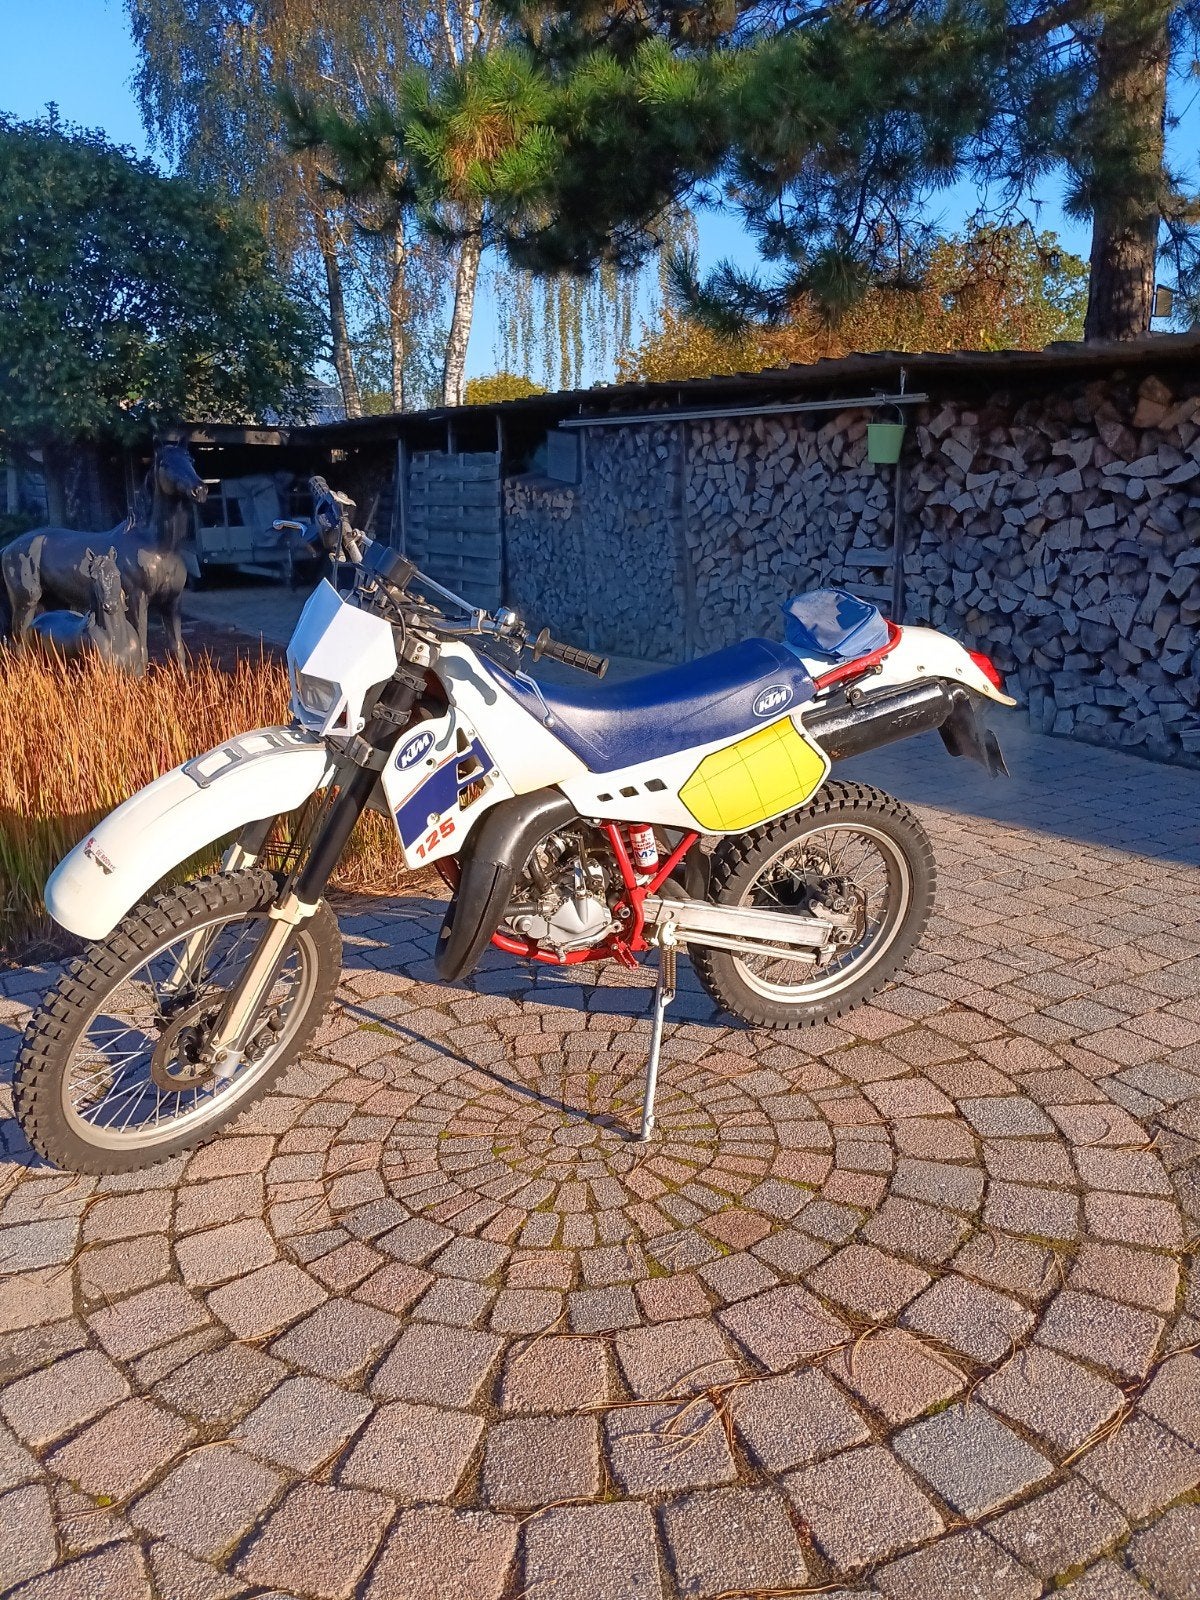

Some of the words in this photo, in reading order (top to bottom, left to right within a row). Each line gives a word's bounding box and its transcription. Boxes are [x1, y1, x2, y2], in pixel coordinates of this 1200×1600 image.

[759, 689, 787, 713] KTM
[400, 734, 431, 768] KTM
[416, 817, 456, 858] 125
